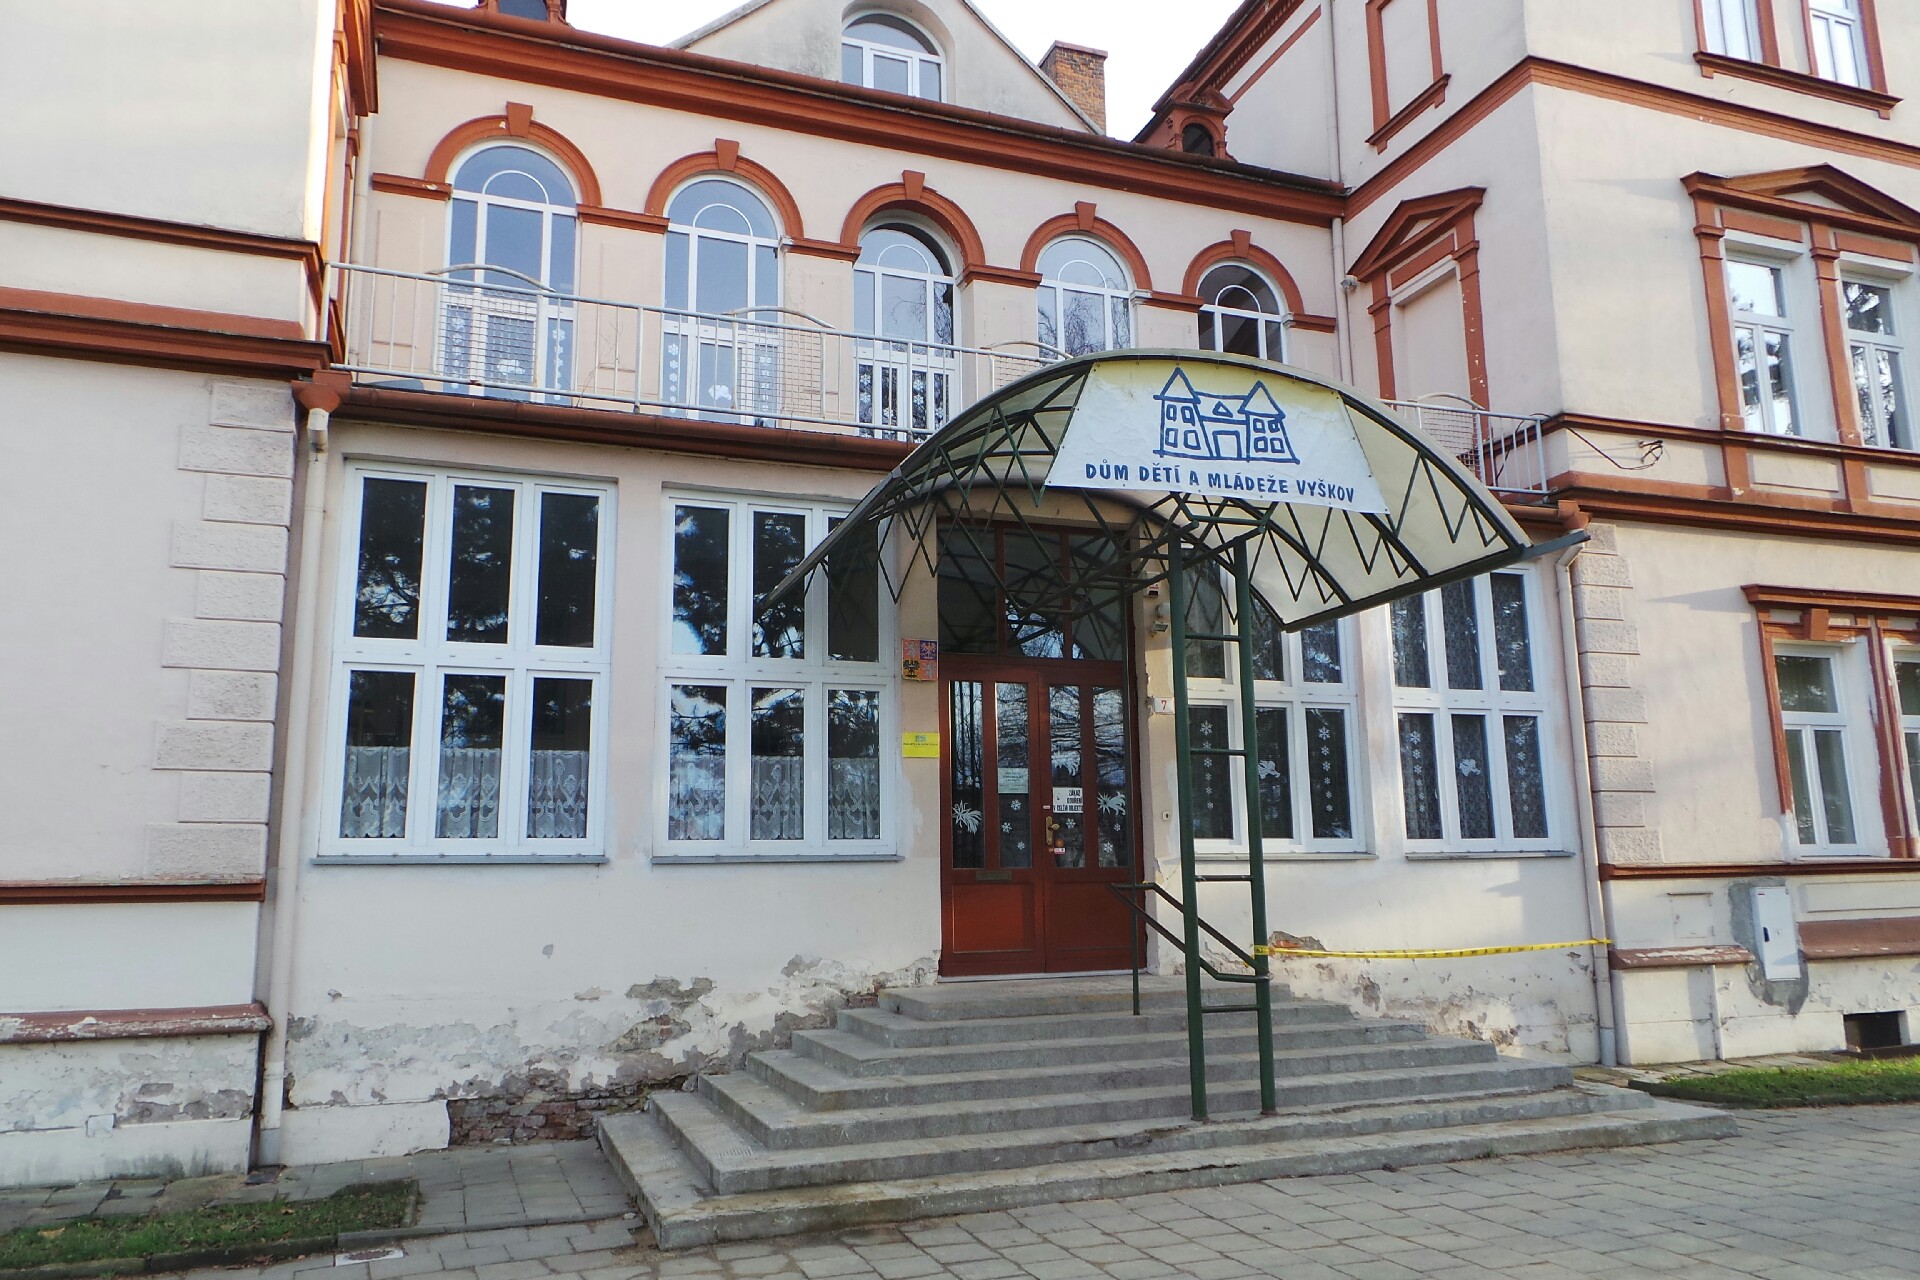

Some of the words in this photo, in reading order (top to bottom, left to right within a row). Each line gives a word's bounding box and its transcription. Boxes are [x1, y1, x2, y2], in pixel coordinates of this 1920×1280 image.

[1085, 459, 1128, 480] DŮM
[1139, 463, 1180, 483] DĚTÍ
[1189, 470, 1199, 485] A
[1207, 472, 1289, 493] MLÁDEŽE
[1296, 478, 1355, 503] VYŠKOV
[1161, 700, 1167, 710] 7
